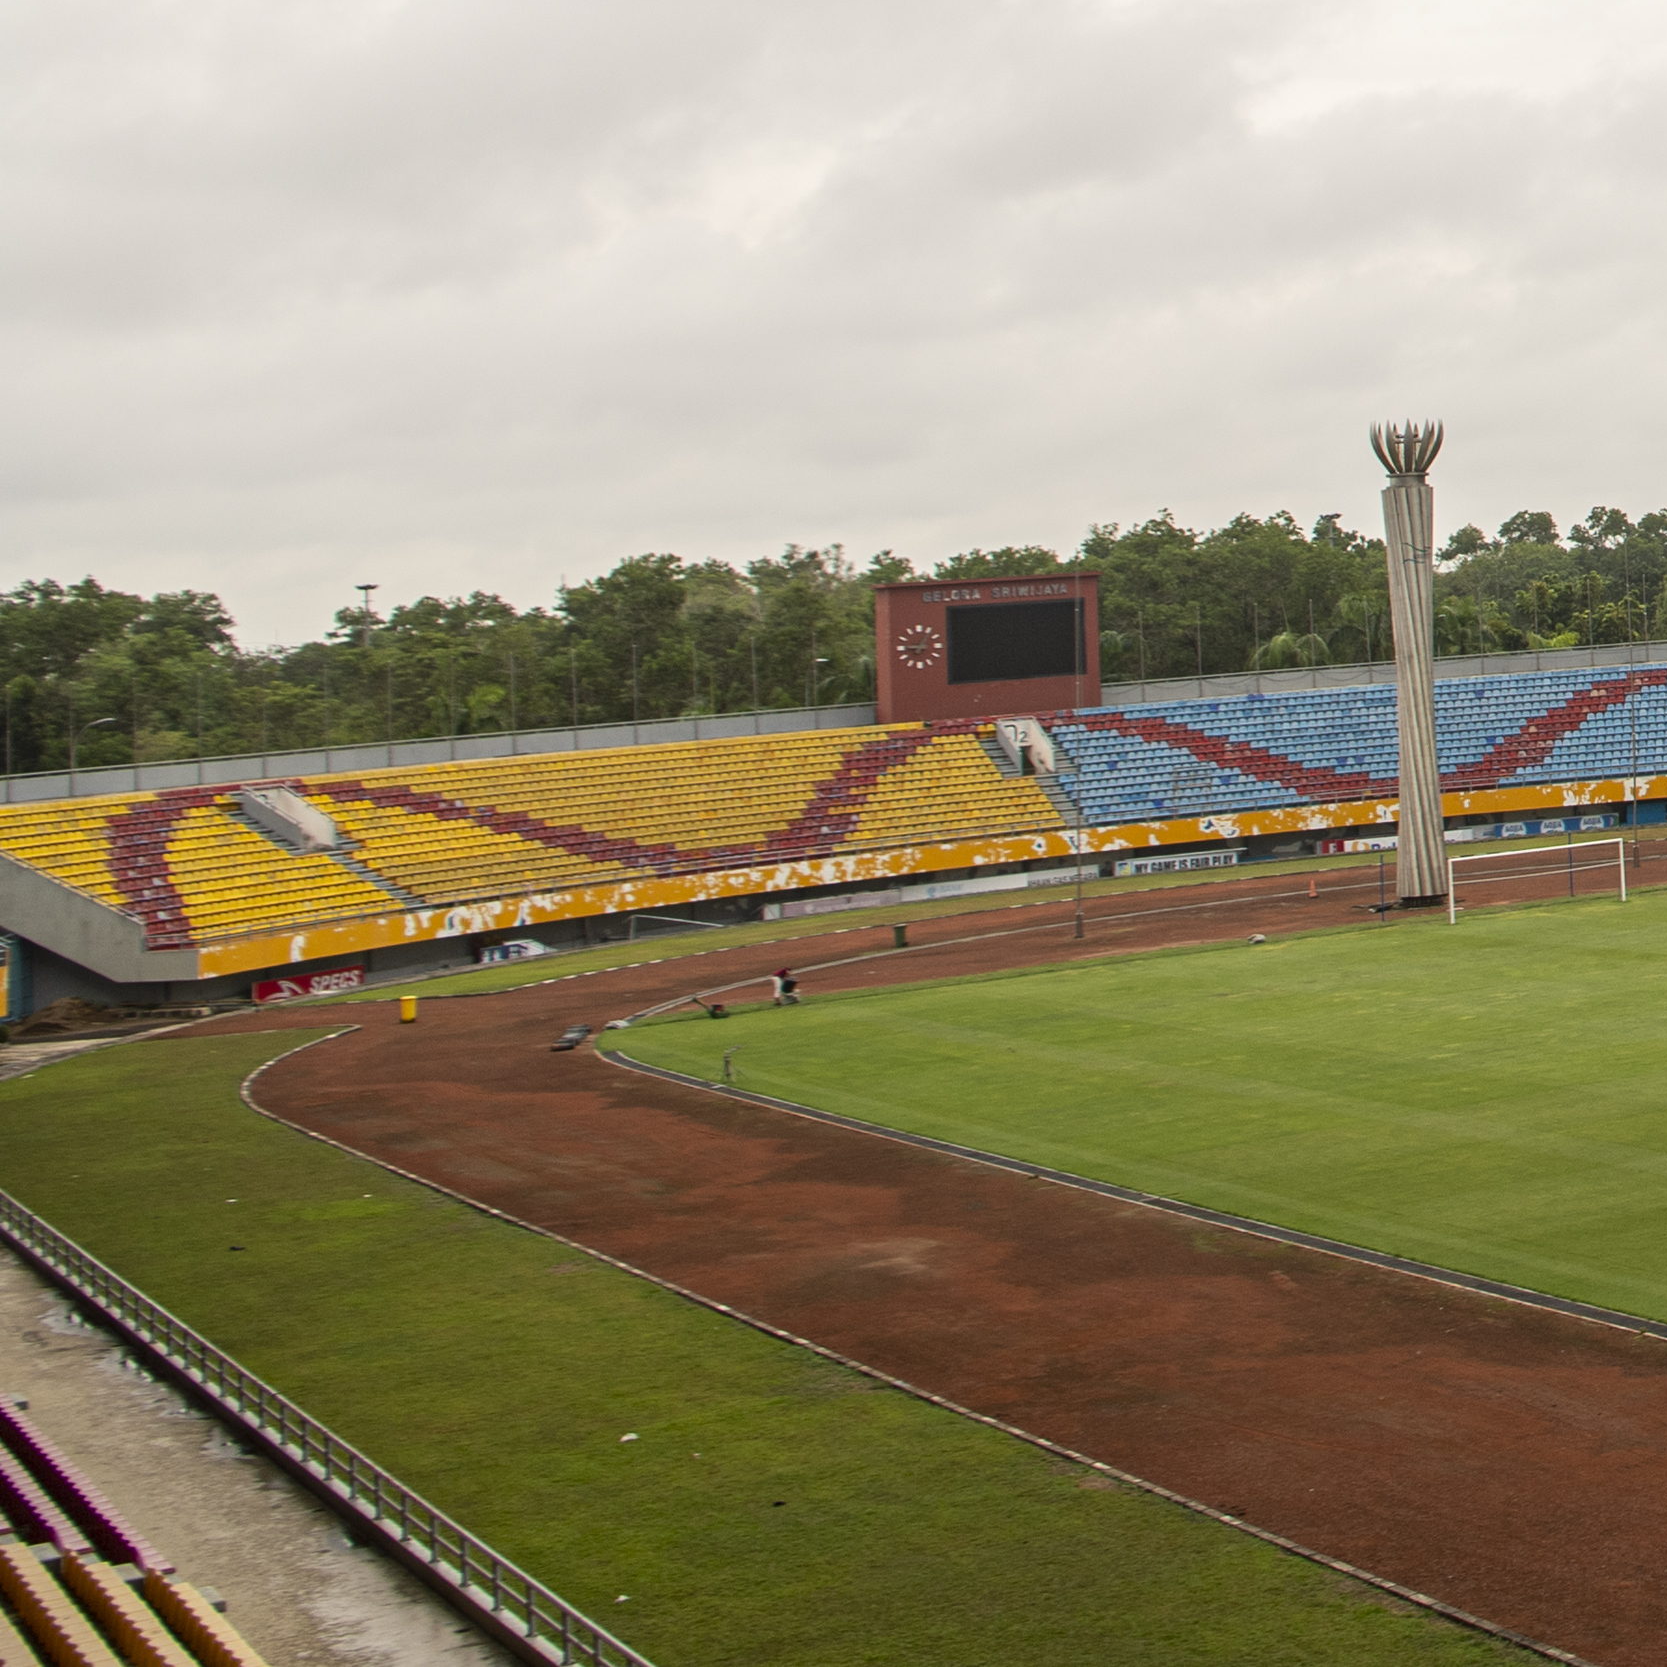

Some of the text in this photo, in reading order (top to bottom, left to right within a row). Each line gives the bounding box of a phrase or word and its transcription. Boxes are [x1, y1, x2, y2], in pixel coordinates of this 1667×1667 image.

[923, 584, 1068, 603] GELORA SRIWIJAYA
[1135, 854, 1234, 874] MY GAME IS FAIR PLAY
[310, 970, 360, 995] SPECS
